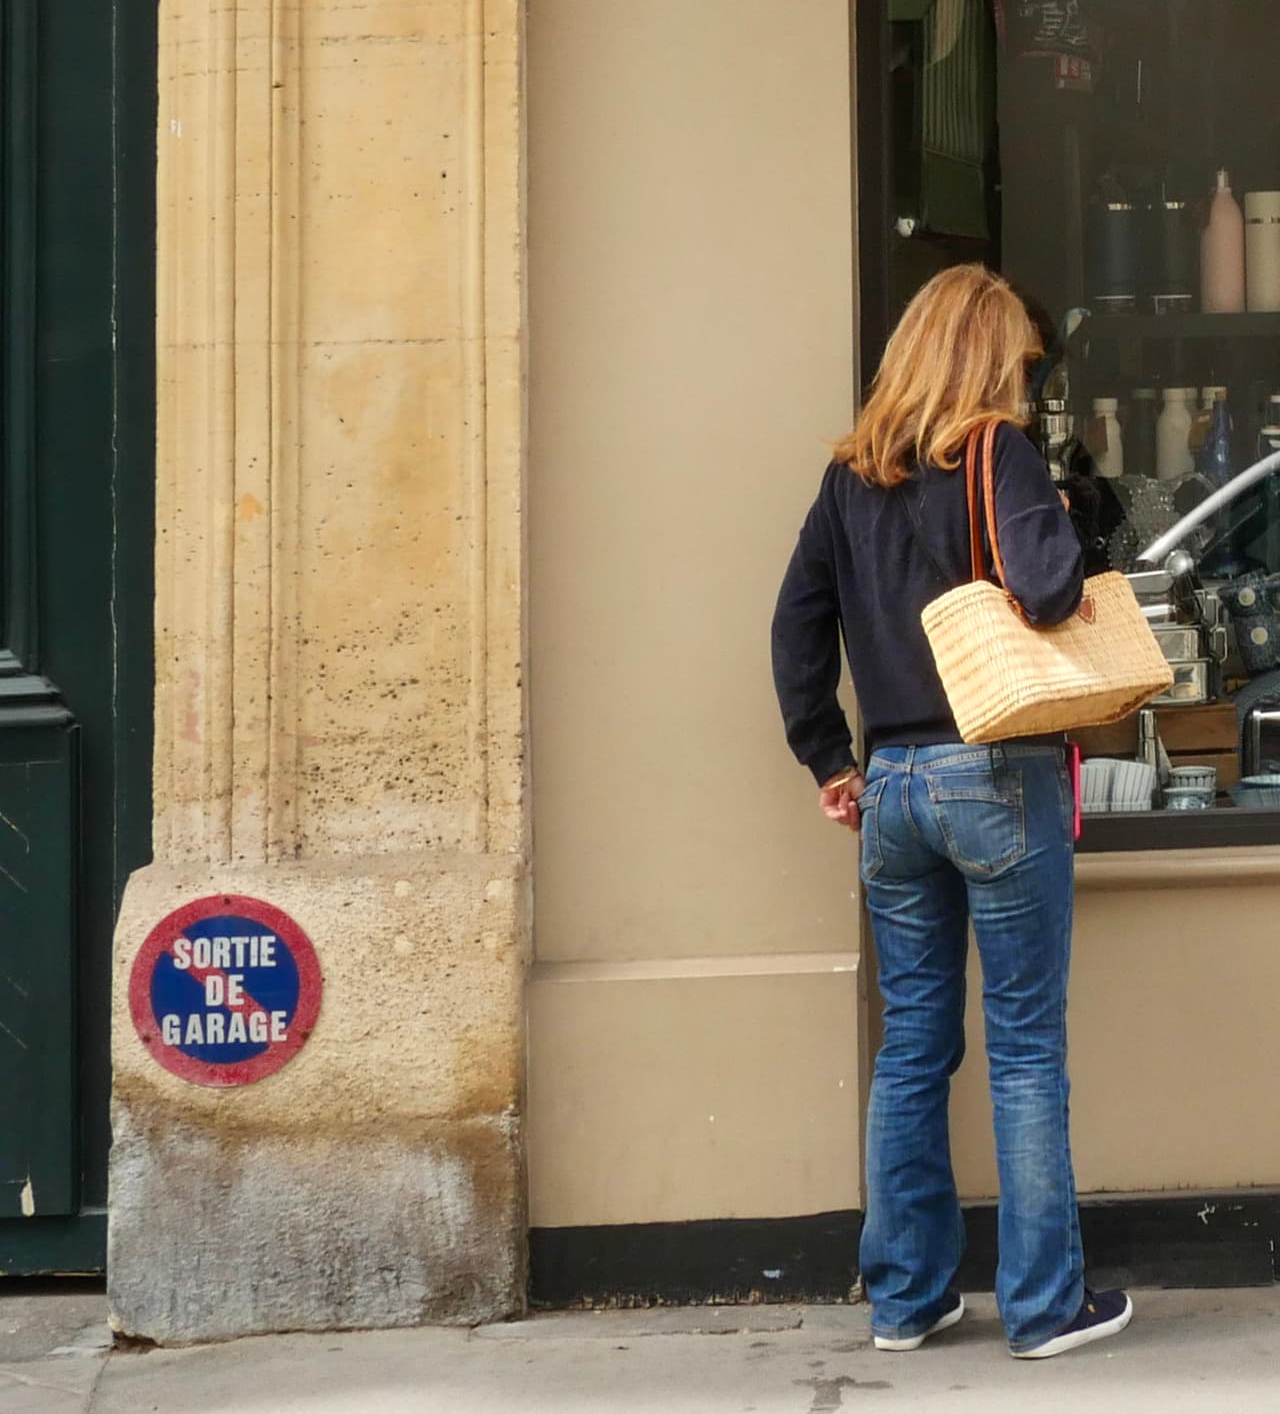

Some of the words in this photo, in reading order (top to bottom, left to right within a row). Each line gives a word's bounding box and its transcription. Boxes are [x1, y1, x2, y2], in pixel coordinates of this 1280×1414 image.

[173, 935, 276, 969] SORTIE
[204, 973, 245, 1007] DE
[161, 1010, 288, 1046] GARAGE
